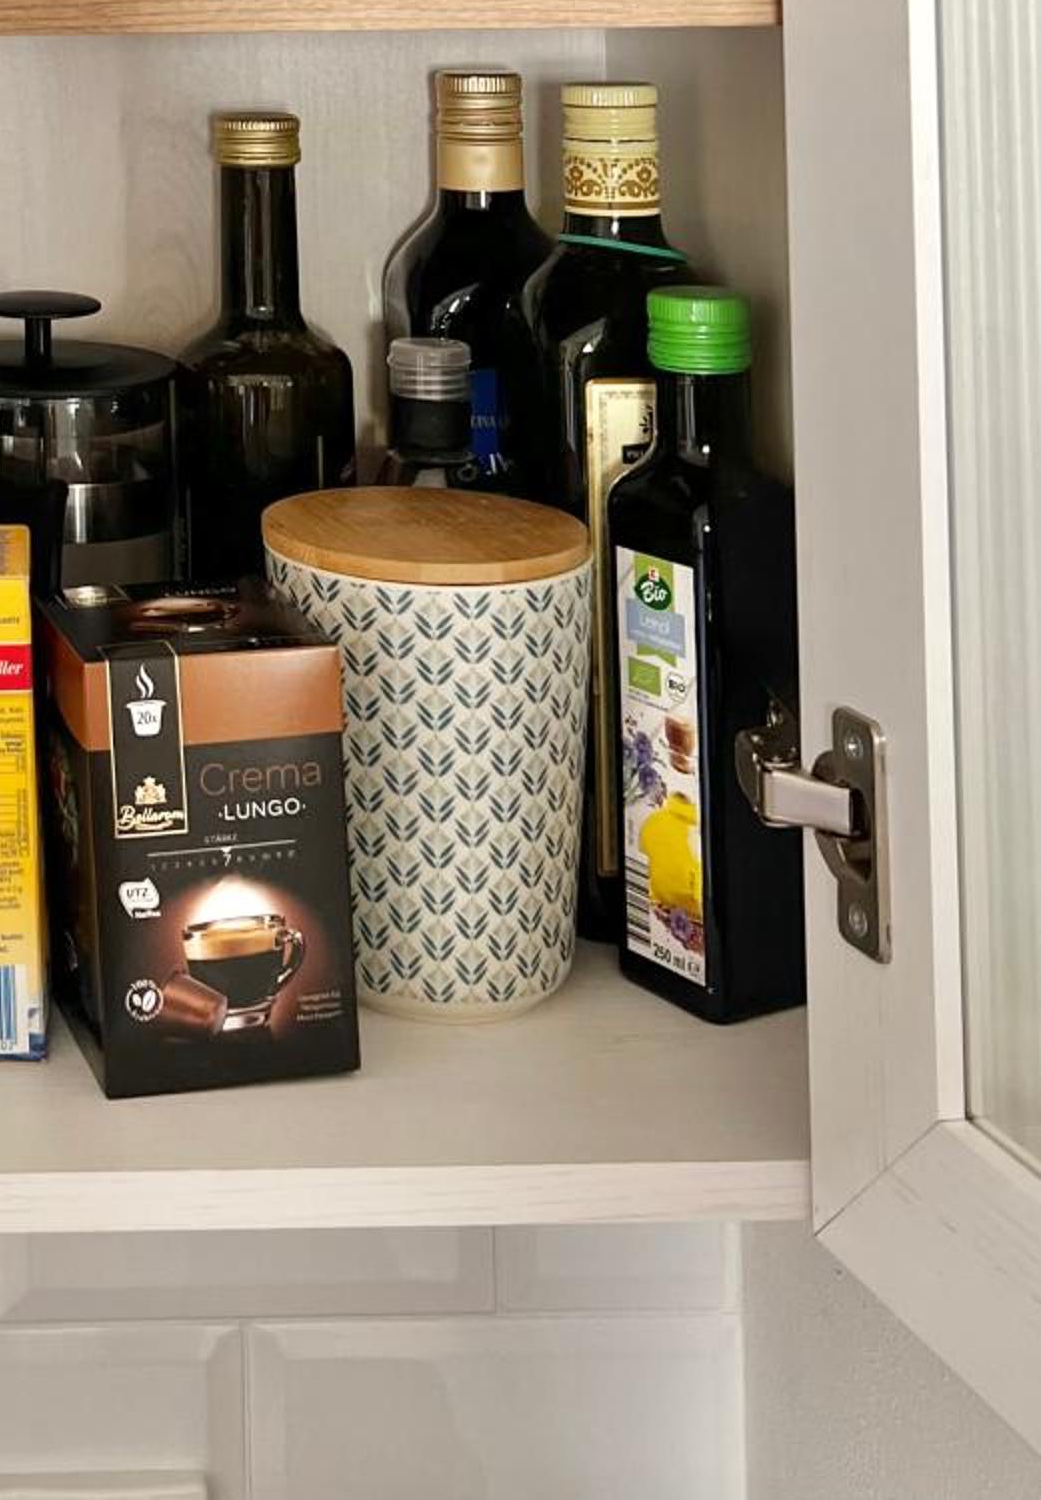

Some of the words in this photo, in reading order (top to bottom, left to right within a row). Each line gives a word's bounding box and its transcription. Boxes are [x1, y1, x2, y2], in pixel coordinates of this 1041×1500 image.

[640, 581, 668, 604] Bio
[137, 711, 158, 725] 20x
[199, 760, 322, 797] Crema
[223, 797, 301, 821] LUNGO
[126, 887, 148, 899] UTZ
[653, 942, 672, 964] 250
